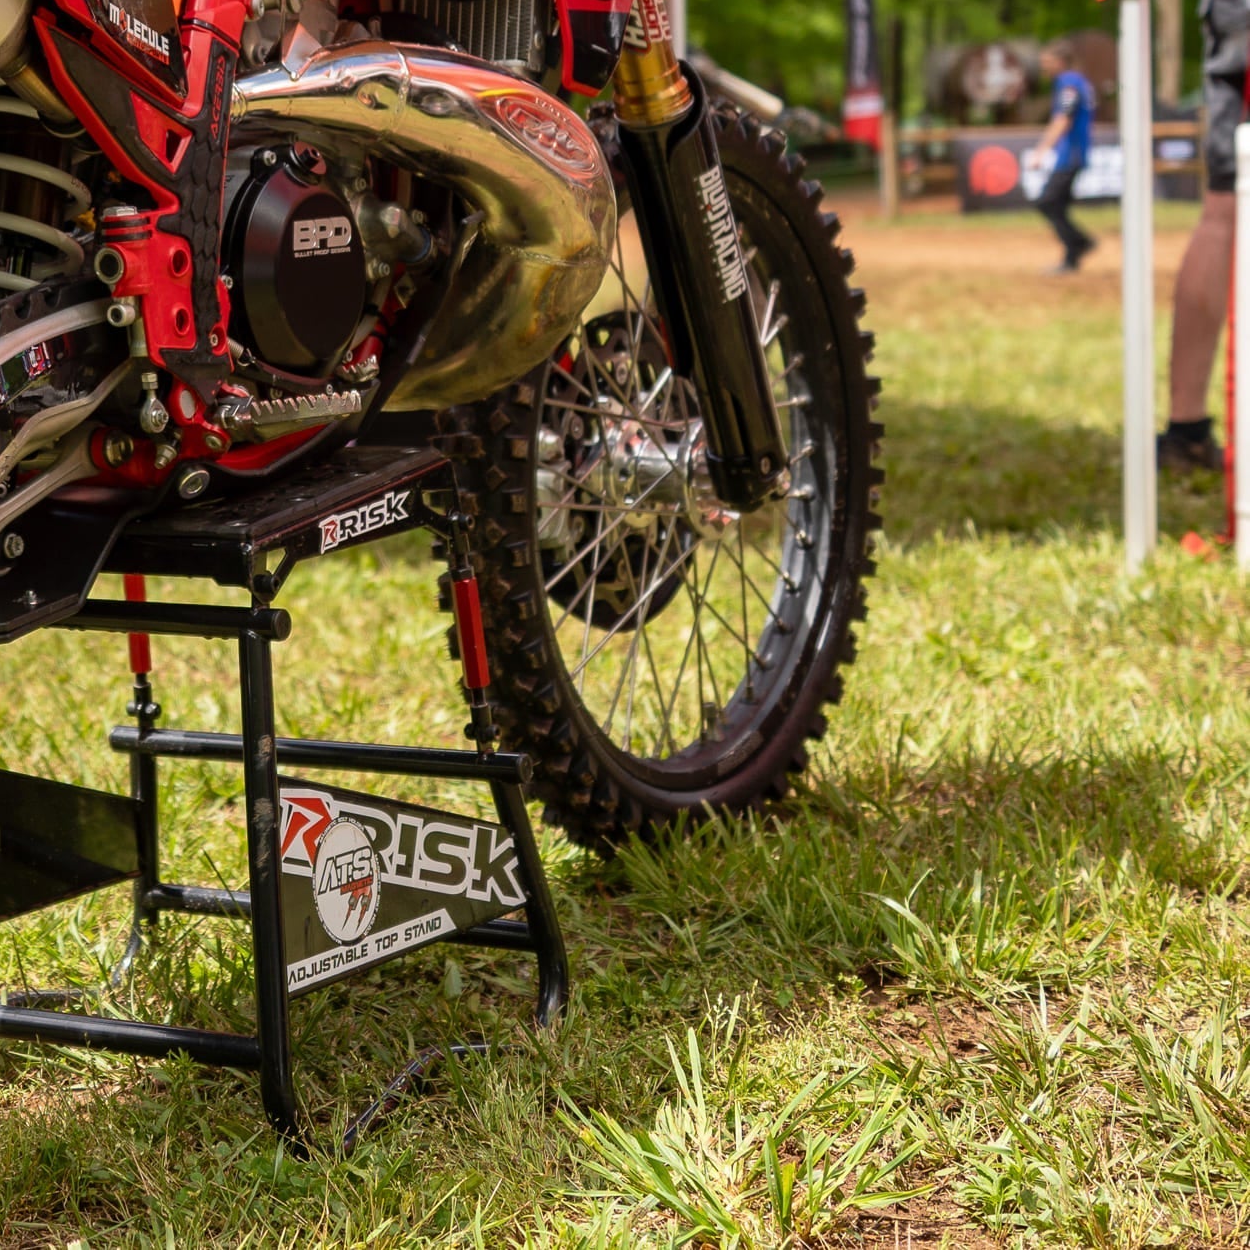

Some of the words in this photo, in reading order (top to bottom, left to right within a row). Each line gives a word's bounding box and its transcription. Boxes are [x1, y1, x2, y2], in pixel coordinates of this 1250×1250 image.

[293, 215, 352, 250] BPD
[710, 217, 747, 301] RACING
[338, 491, 411, 545] RISK
[332, 799, 527, 908] RISK
[287, 943, 369, 986] ADJUSTABLE
[374, 931, 399, 953] TOP
[404, 915, 442, 942] STAND
